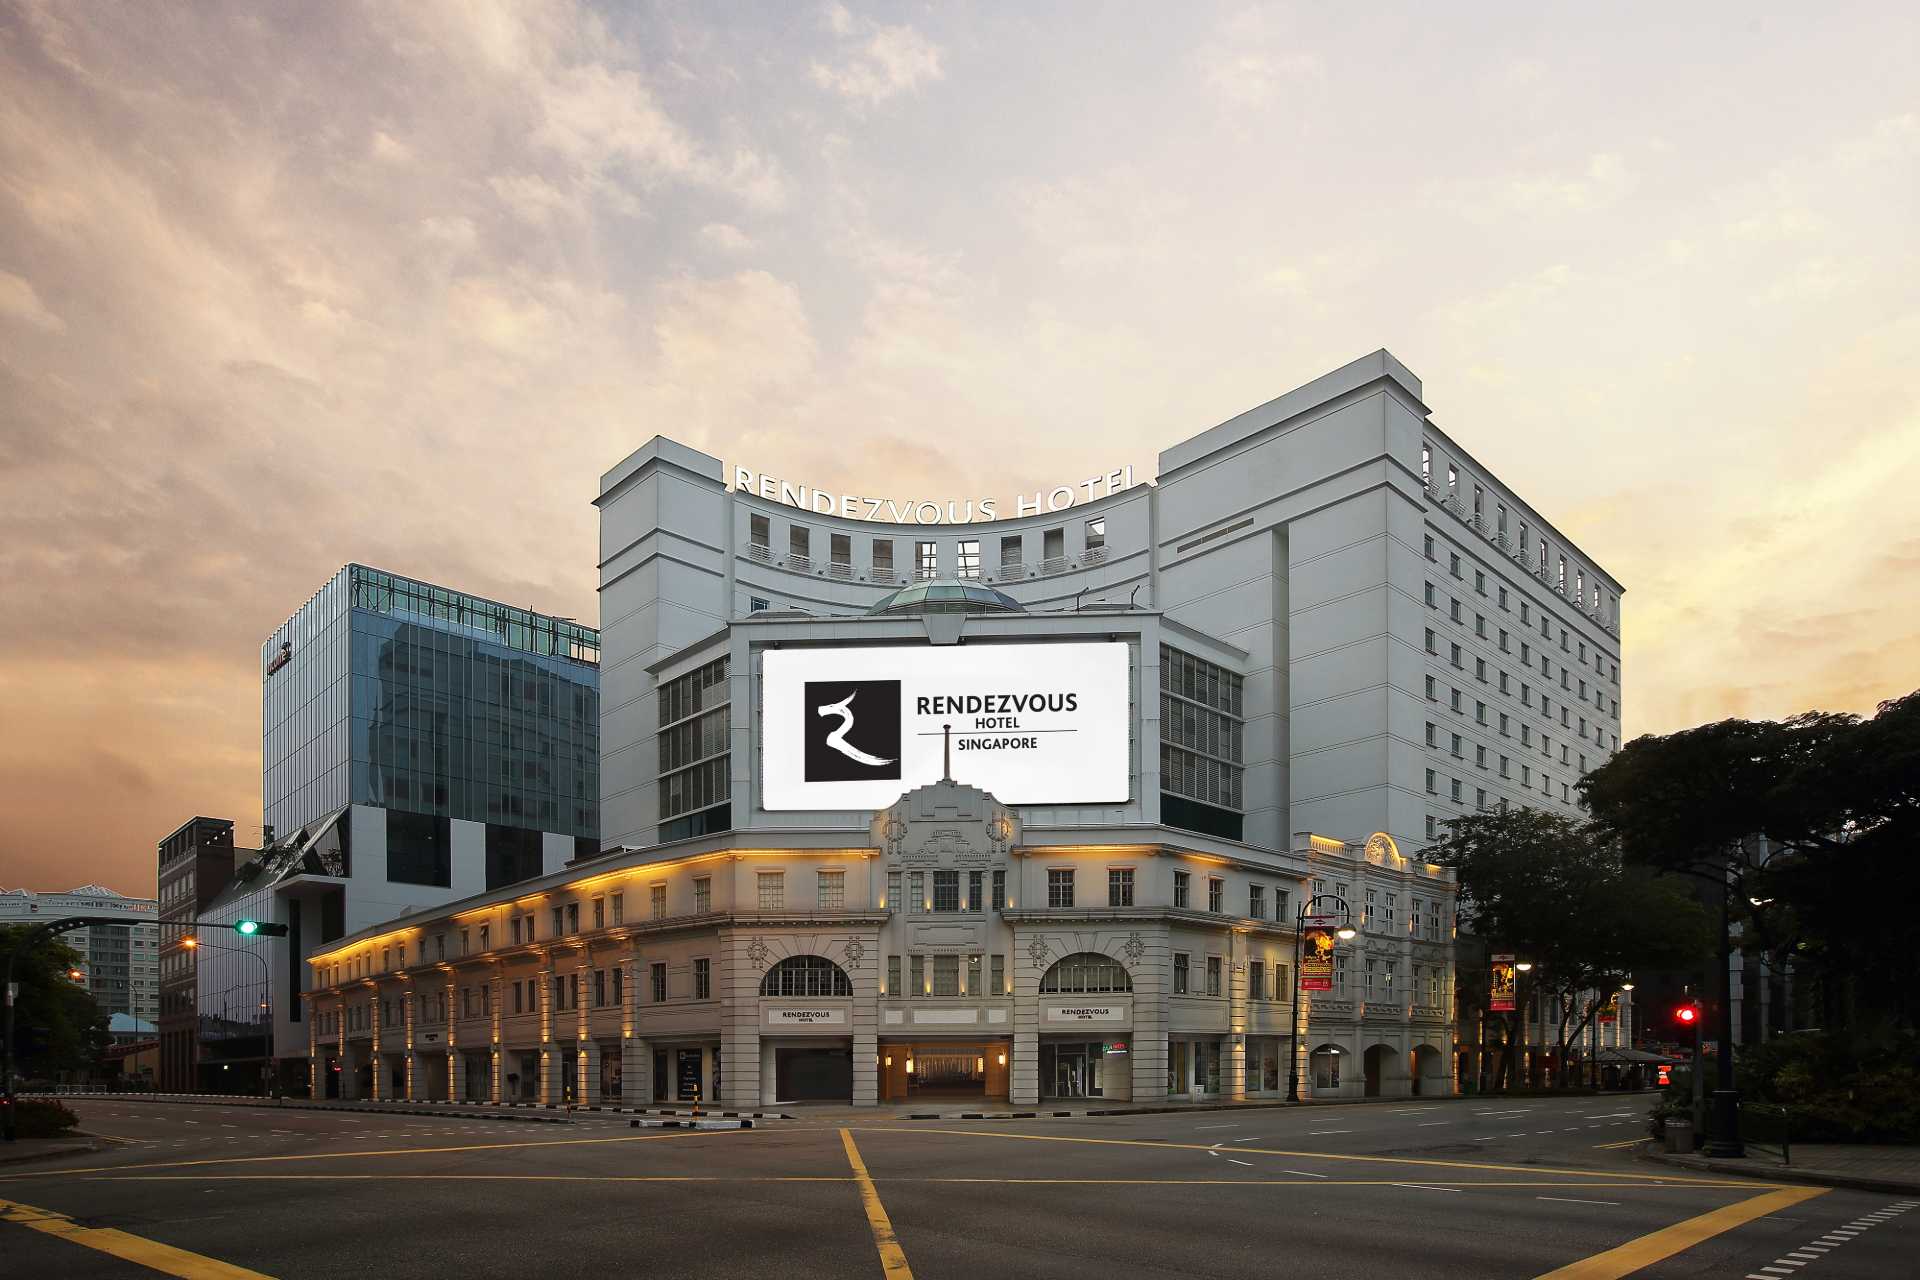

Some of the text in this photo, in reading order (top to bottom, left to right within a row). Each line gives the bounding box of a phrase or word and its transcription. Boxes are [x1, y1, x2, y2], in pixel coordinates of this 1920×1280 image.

[734, 464, 998, 525] RENDEZVOUS
[917, 693, 1078, 715] RENDEZVOUS
[975, 717, 1020, 729] HOTEL
[958, 737, 1038, 751] SINGAPORE
